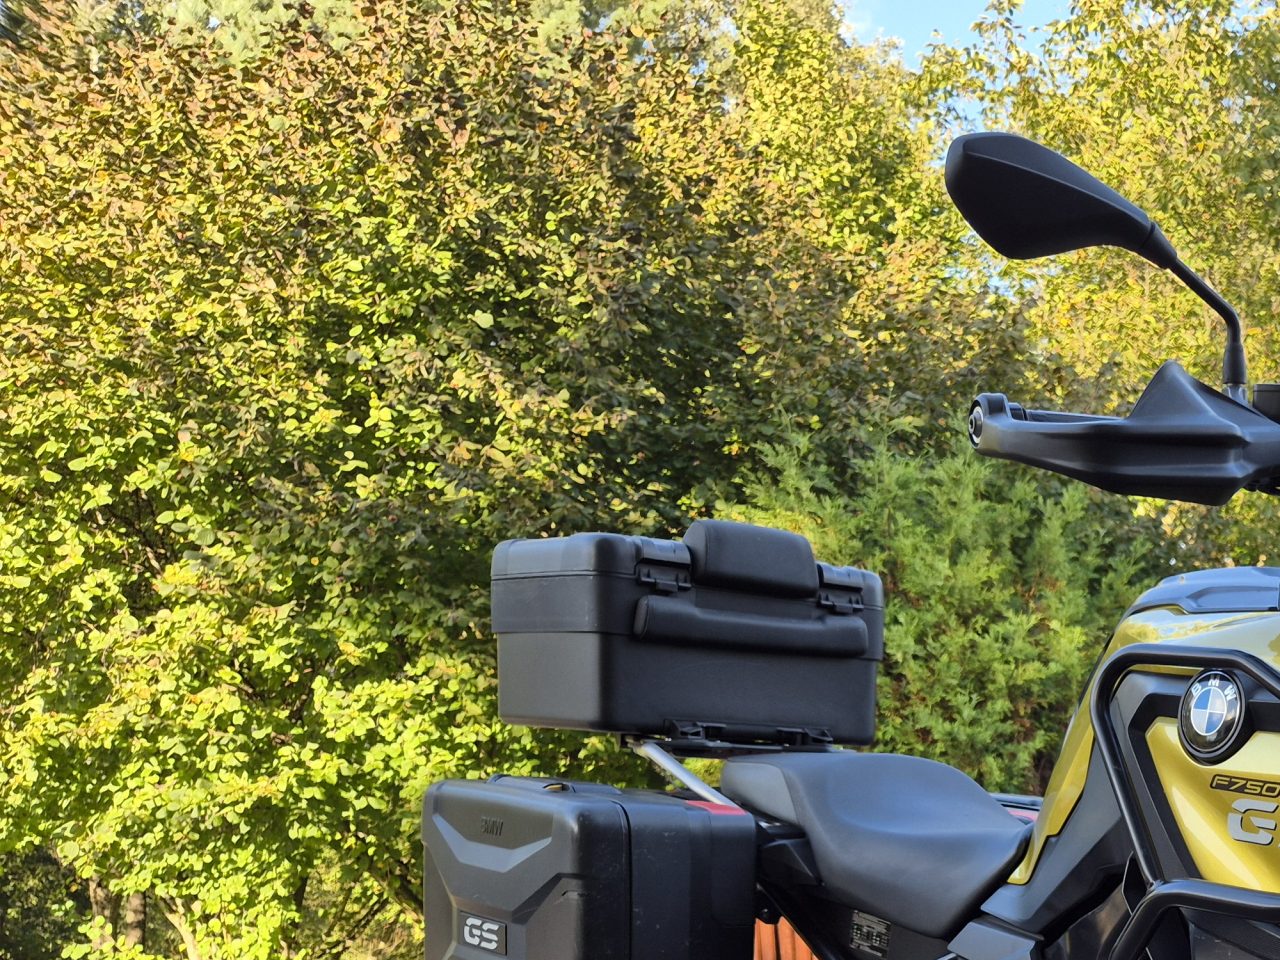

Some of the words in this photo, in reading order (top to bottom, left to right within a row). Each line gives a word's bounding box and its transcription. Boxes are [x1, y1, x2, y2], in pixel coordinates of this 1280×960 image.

[1190, 677, 1237, 701] BMW
[481, 816, 504, 836] BMW
[464, 917, 499, 950] GS
